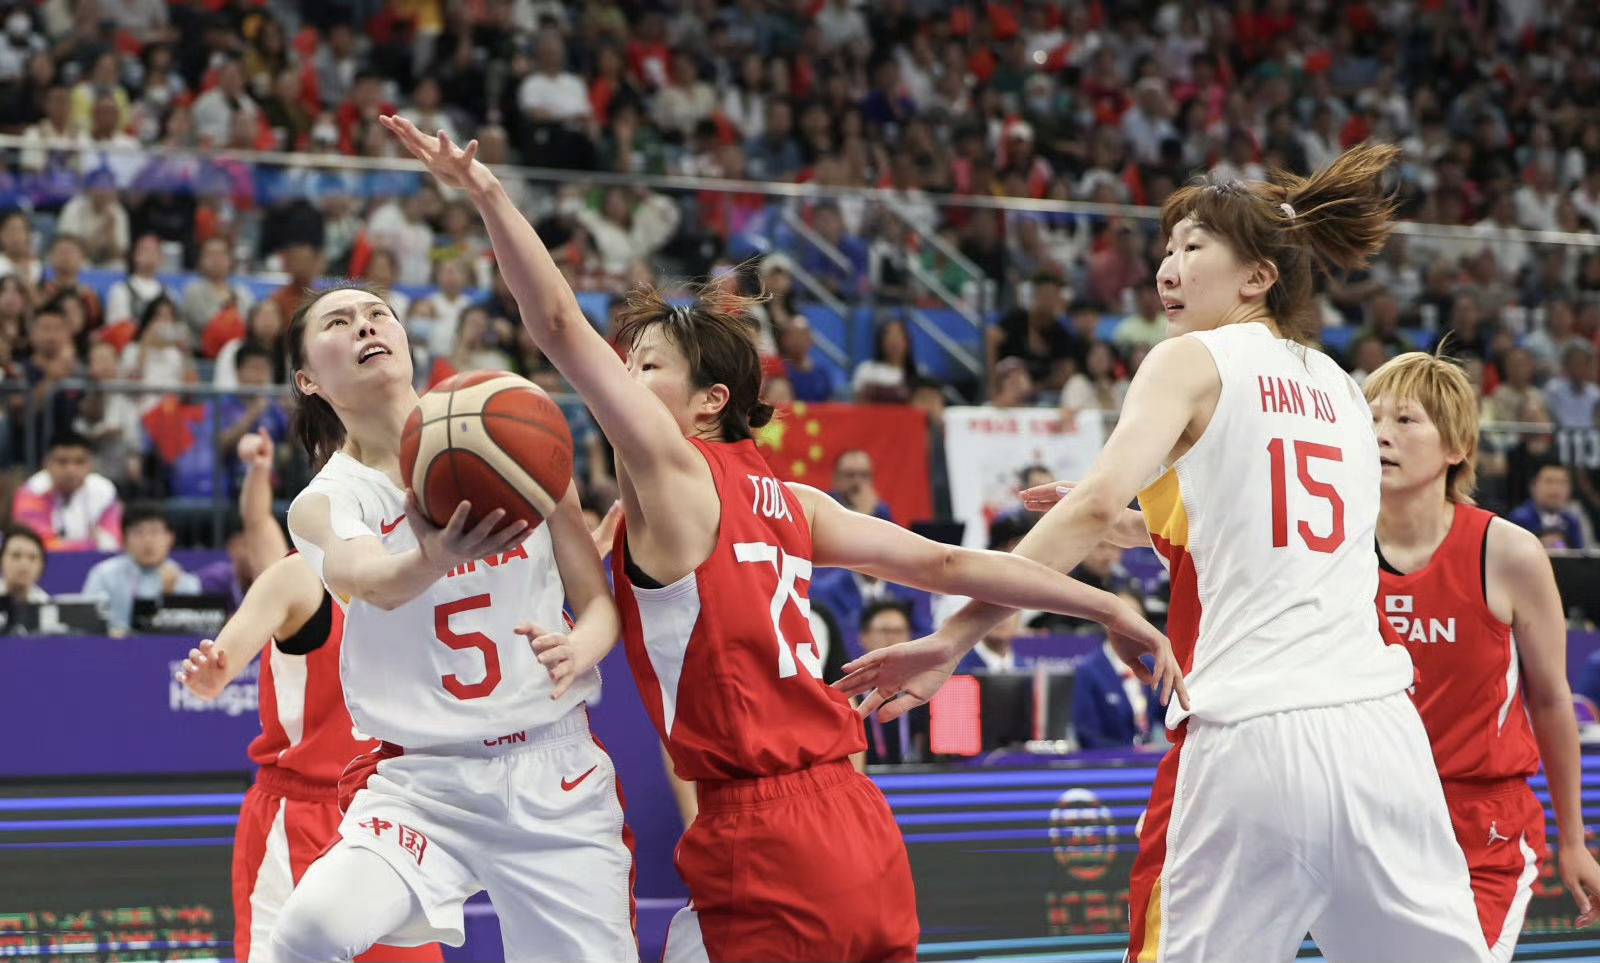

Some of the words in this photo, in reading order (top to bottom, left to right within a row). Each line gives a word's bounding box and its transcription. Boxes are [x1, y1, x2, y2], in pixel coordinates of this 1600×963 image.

[1257, 375, 1306, 417] HAN
[1306, 385, 1336, 424] XU
[1266, 437, 1346, 554] 15
[434, 592, 502, 701] 5
[732, 541, 824, 680] 75
[1386, 615, 1456, 644] PAN
[358, 816, 428, 867] 中国
